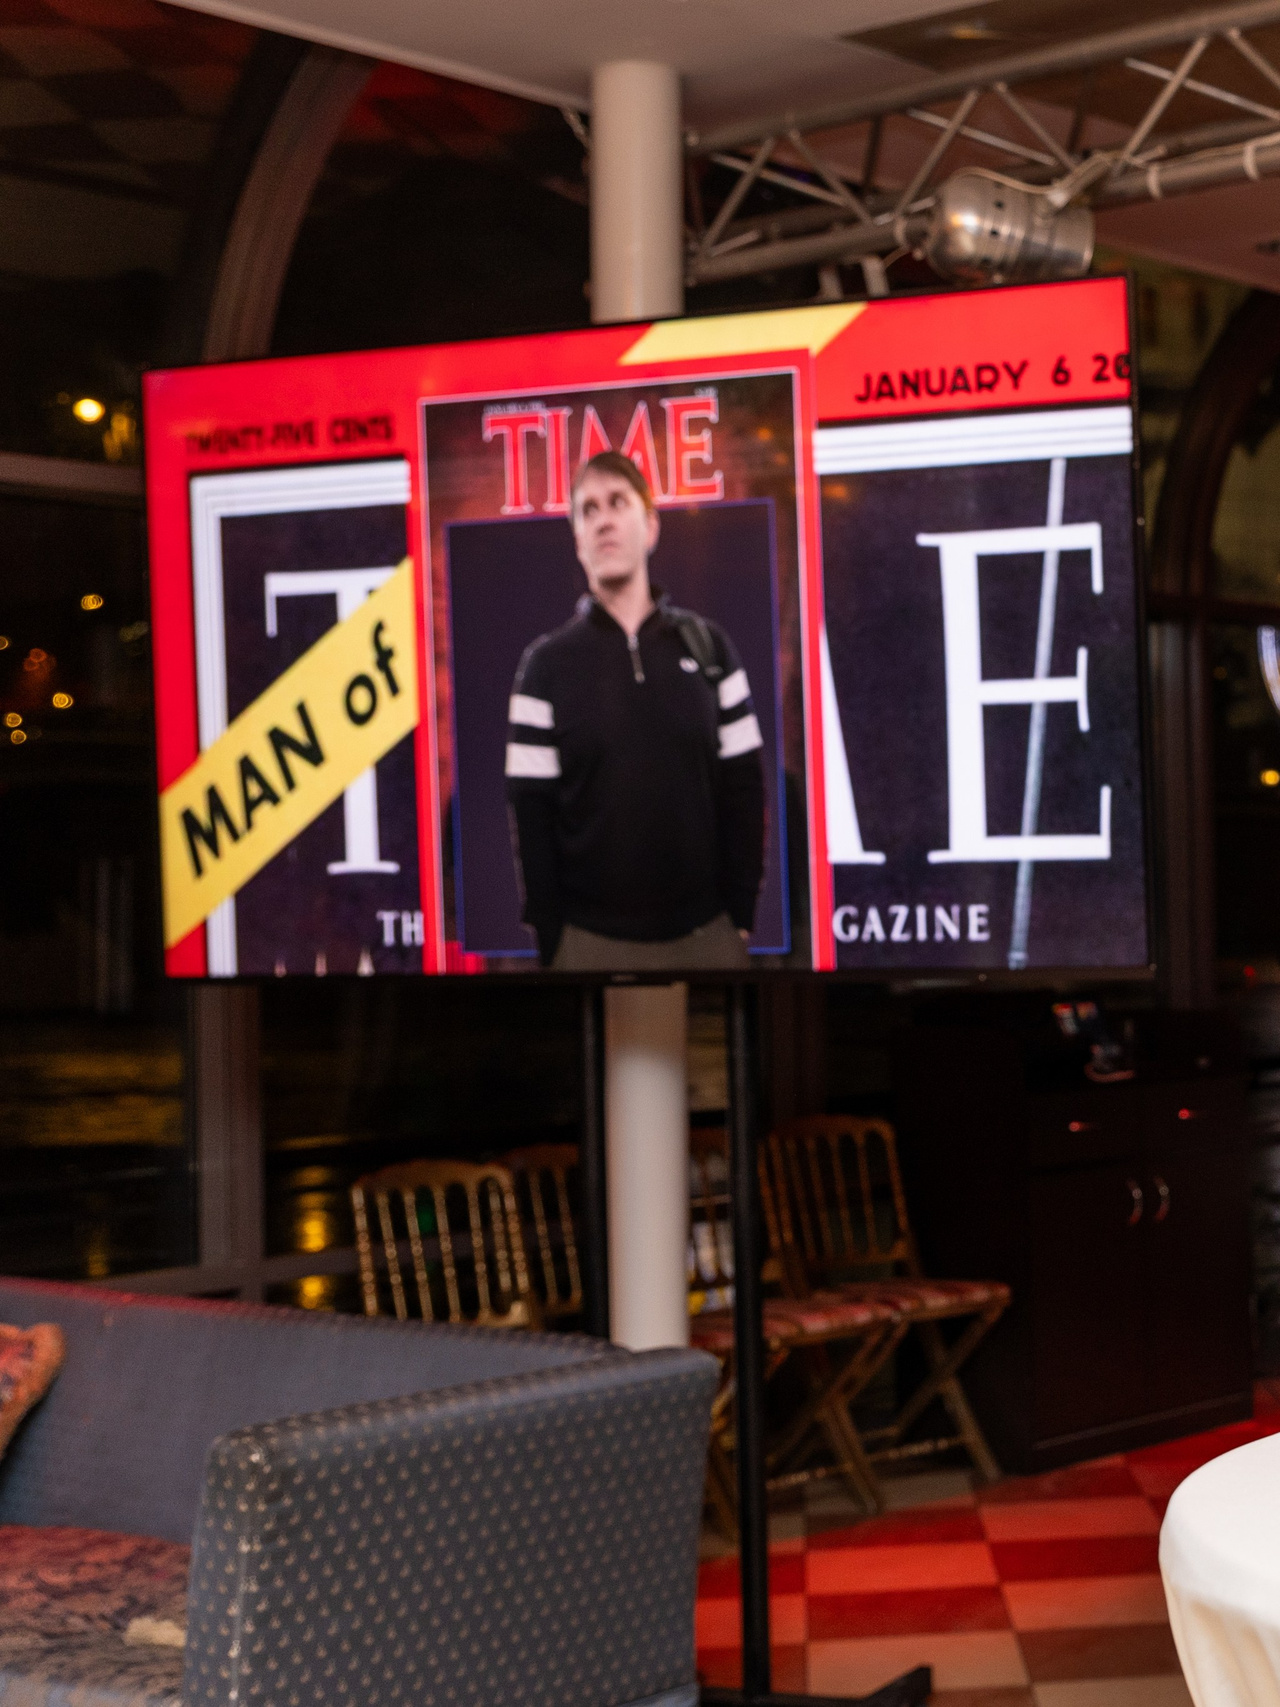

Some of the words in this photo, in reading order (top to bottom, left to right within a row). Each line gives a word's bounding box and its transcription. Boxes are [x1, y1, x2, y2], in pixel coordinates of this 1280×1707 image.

[855, 359, 1029, 403] JANUARY
[1052, 354, 1072, 387] 6
[180, 698, 326, 879] MAN
[345, 619, 400, 726] of
[831, 903, 991, 943] GAZINE
